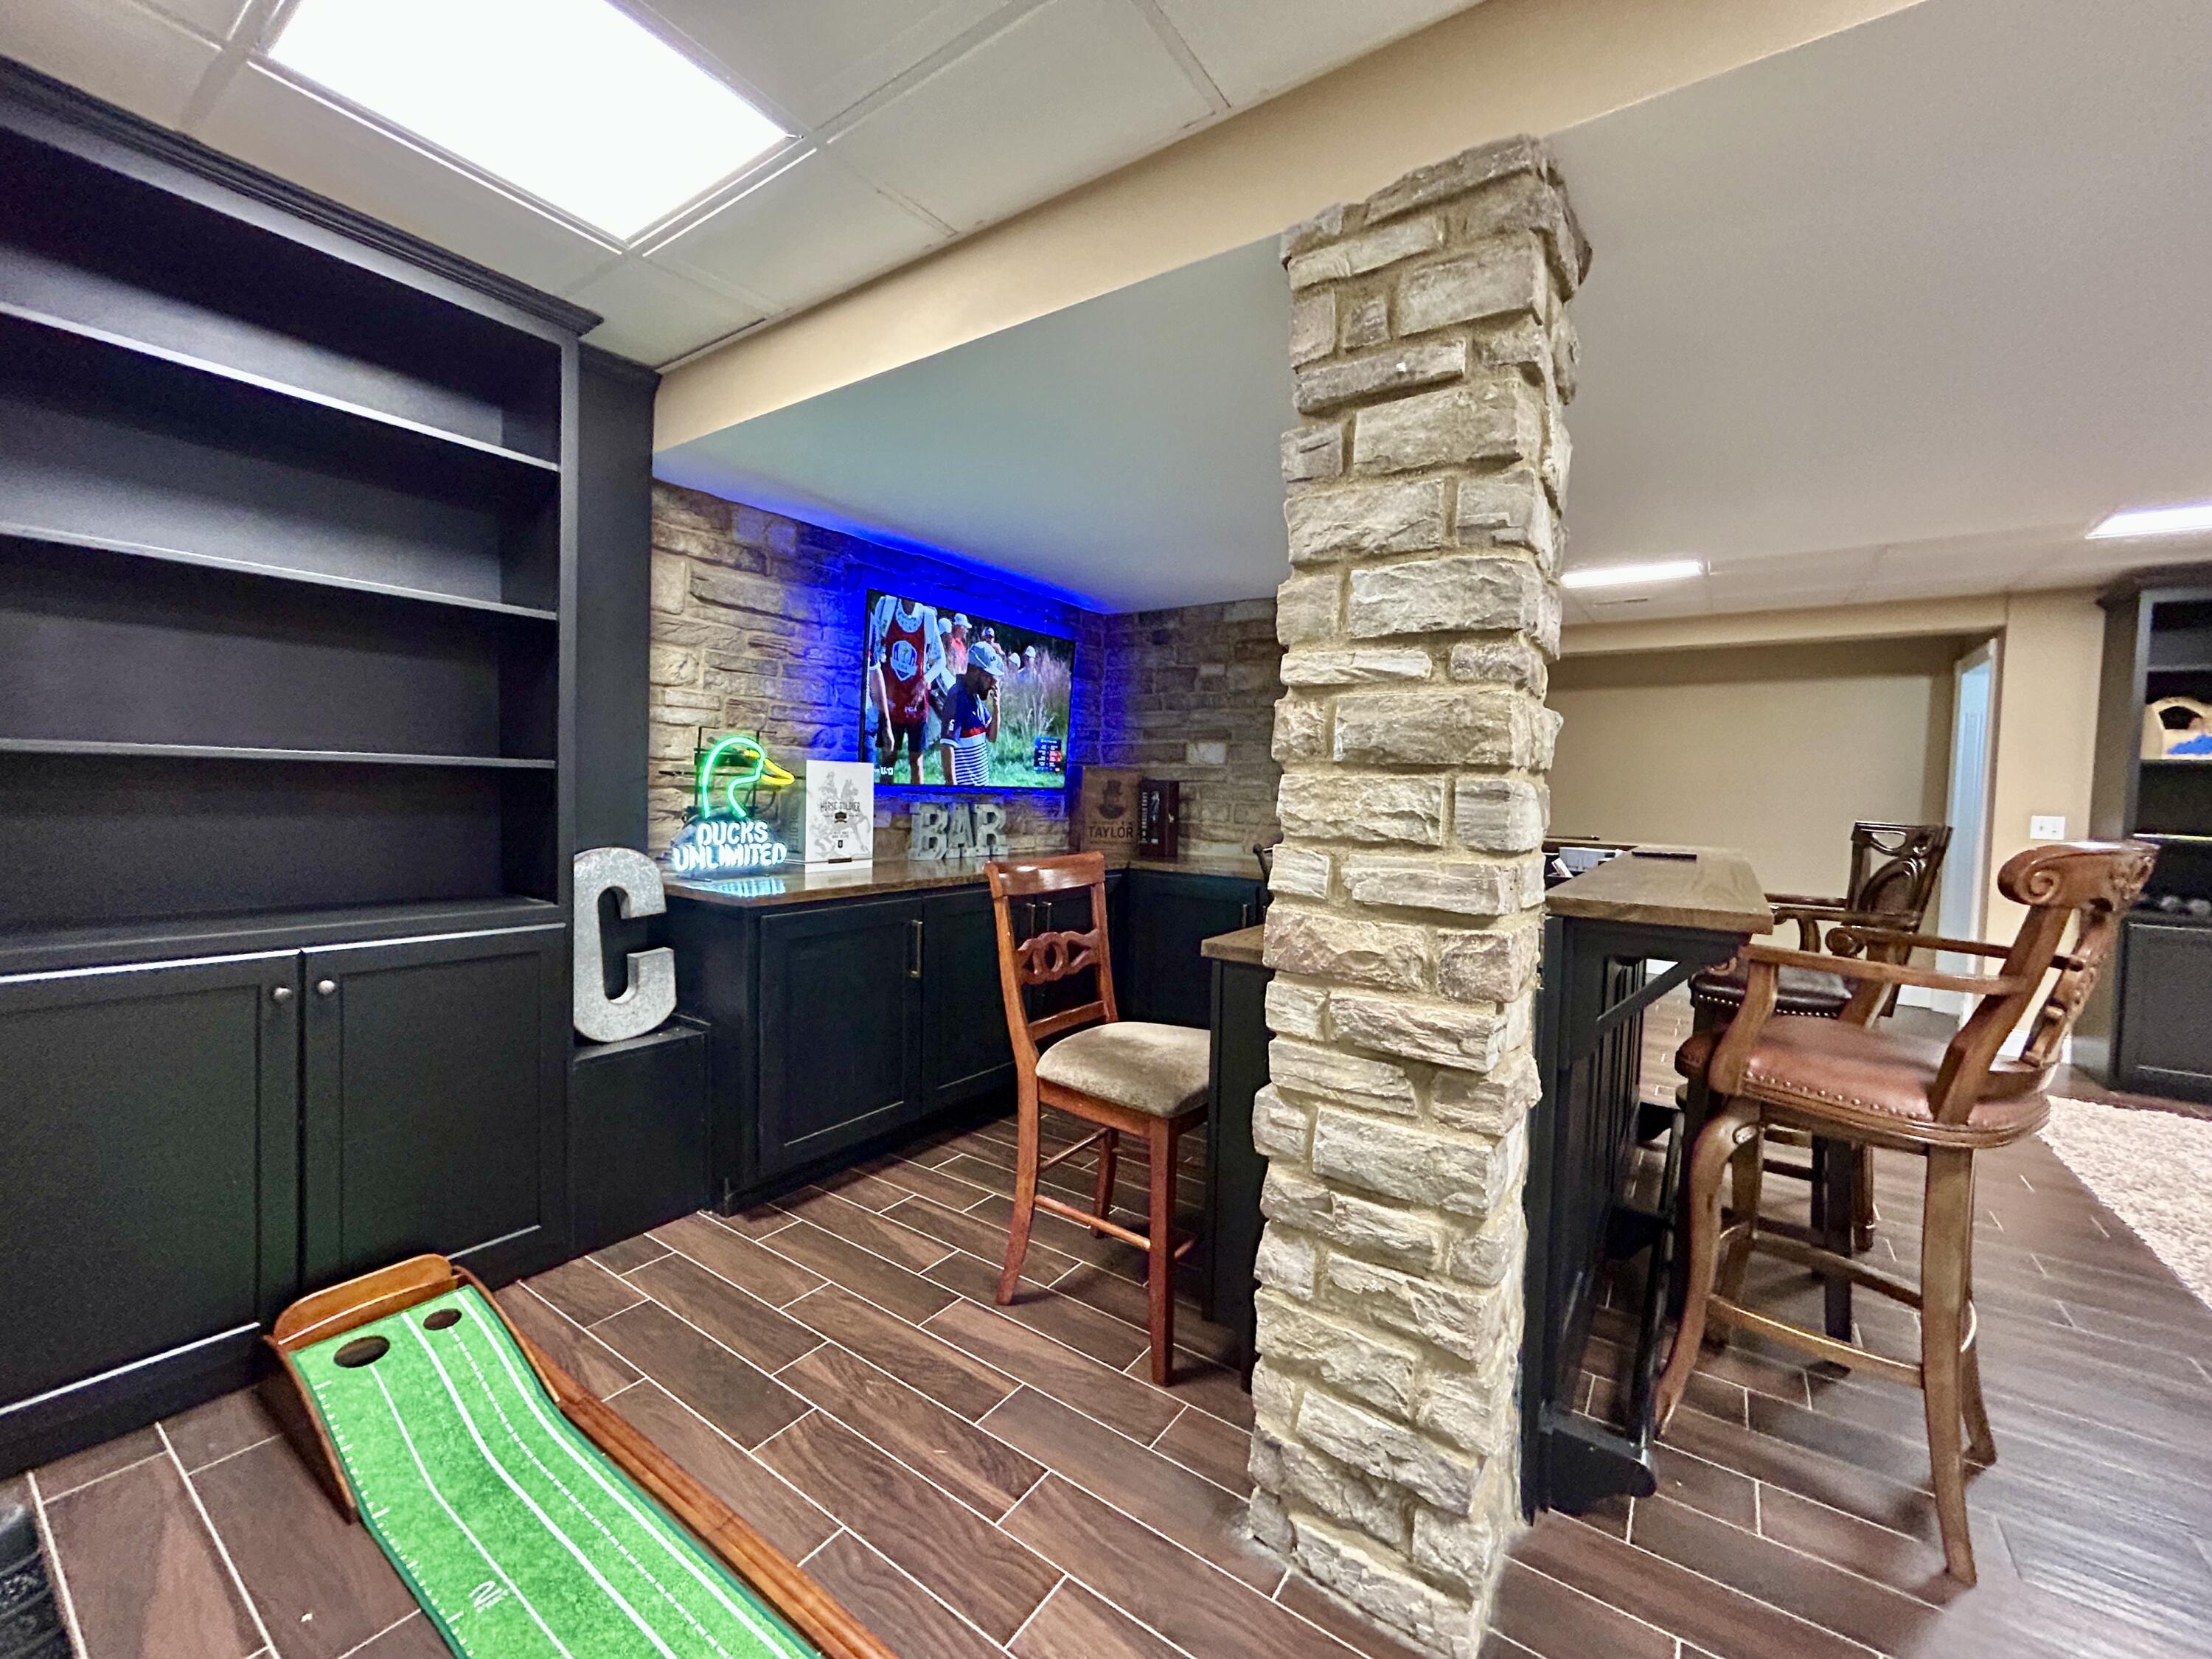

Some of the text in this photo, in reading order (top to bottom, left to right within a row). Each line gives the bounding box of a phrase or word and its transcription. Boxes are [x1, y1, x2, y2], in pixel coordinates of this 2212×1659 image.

[698, 821, 769, 846] DUCKS
[908, 802, 1008, 861] BAR
[1088, 826, 1134, 838] TAYLOR
[672, 842, 787, 872] UNLIMITED
